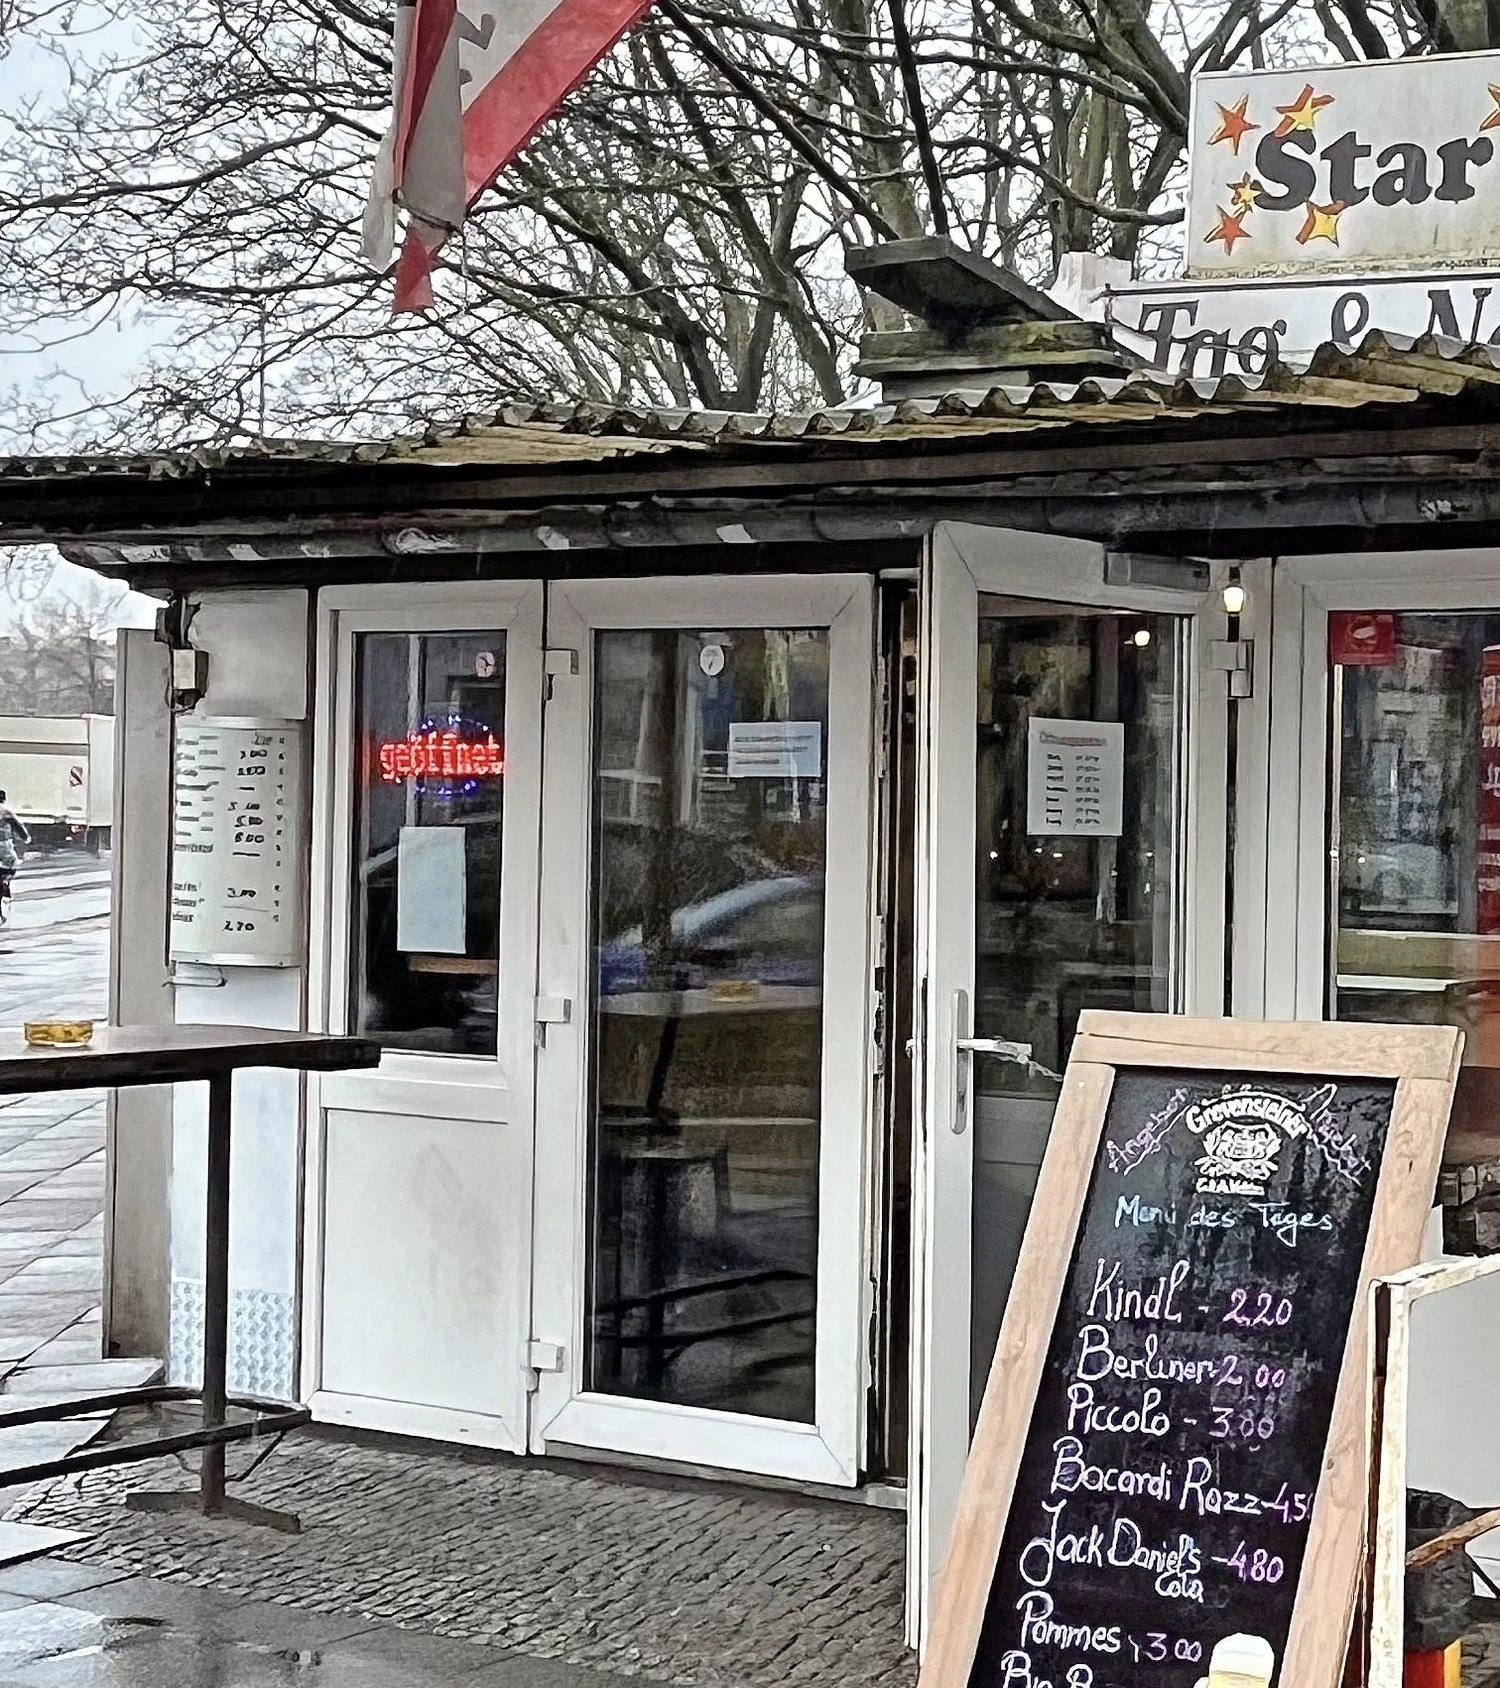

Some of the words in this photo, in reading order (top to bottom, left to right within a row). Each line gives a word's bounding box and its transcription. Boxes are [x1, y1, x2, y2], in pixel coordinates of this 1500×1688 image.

[1253, 127, 1495, 212] Star
[1189, 1204, 1238, 1228] des
[1086, 1258, 1190, 1323] Kindl
[1067, 1382, 1170, 1436] Piccolo
[1019, 1499, 1104, 1587] Jack
[1016, 1590, 1121, 1653] Pommes
